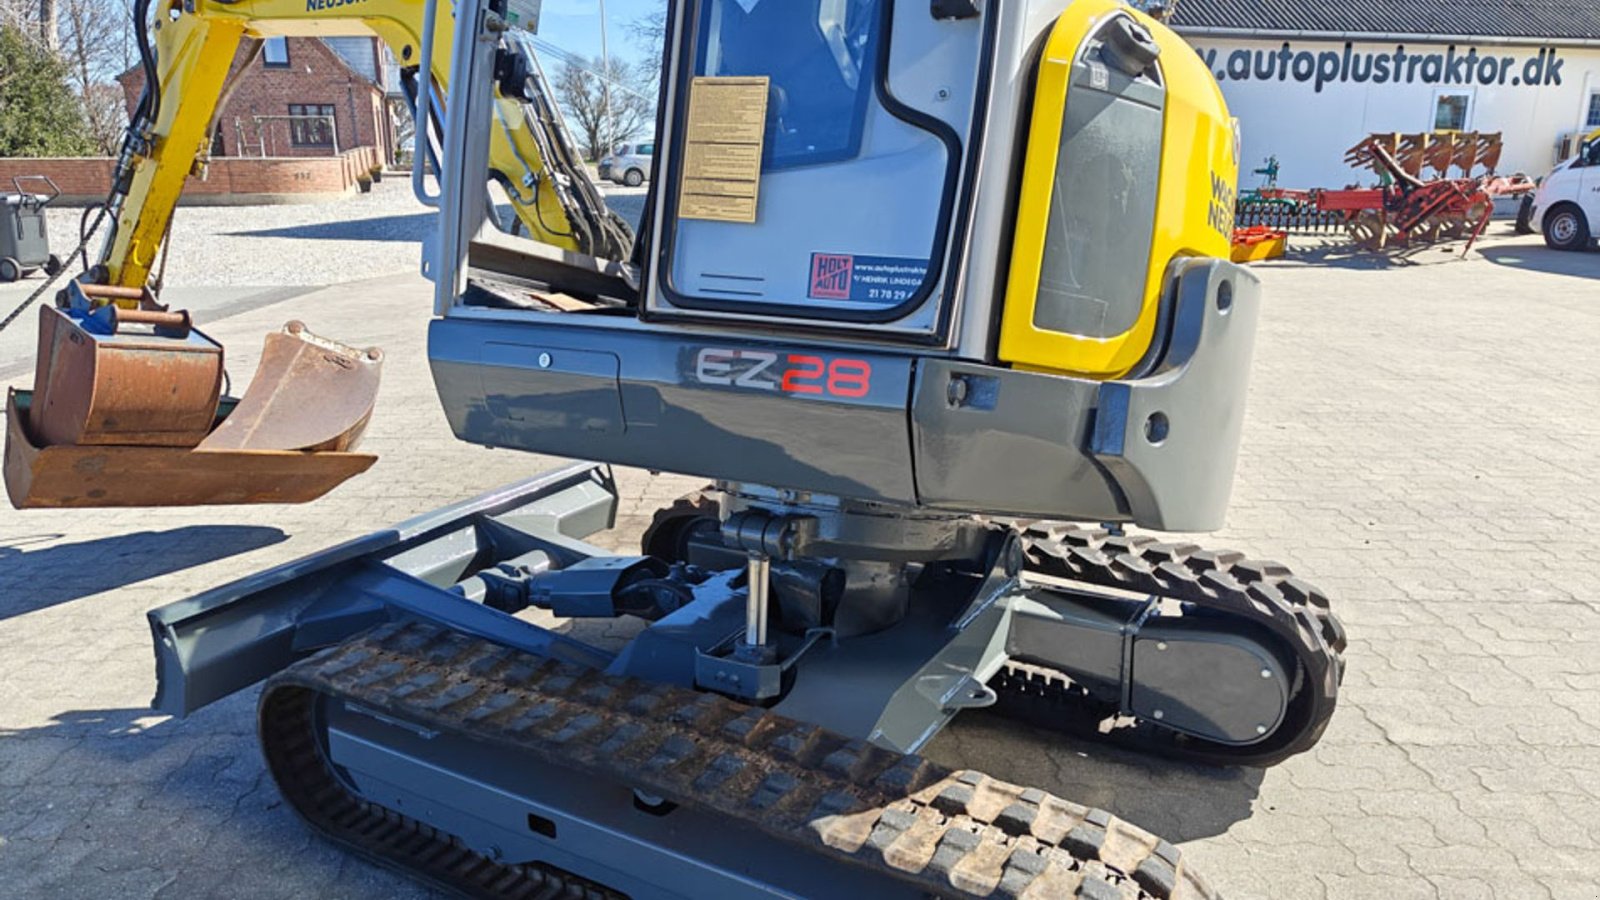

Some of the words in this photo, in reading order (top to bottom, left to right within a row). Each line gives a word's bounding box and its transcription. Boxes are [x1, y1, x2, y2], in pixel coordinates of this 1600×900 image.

[306, 0, 368, 12] NEUS
[817, 257, 849, 281] HOLT
[868, 289, 879, 298] 21
[893, 290, 906, 300] 29
